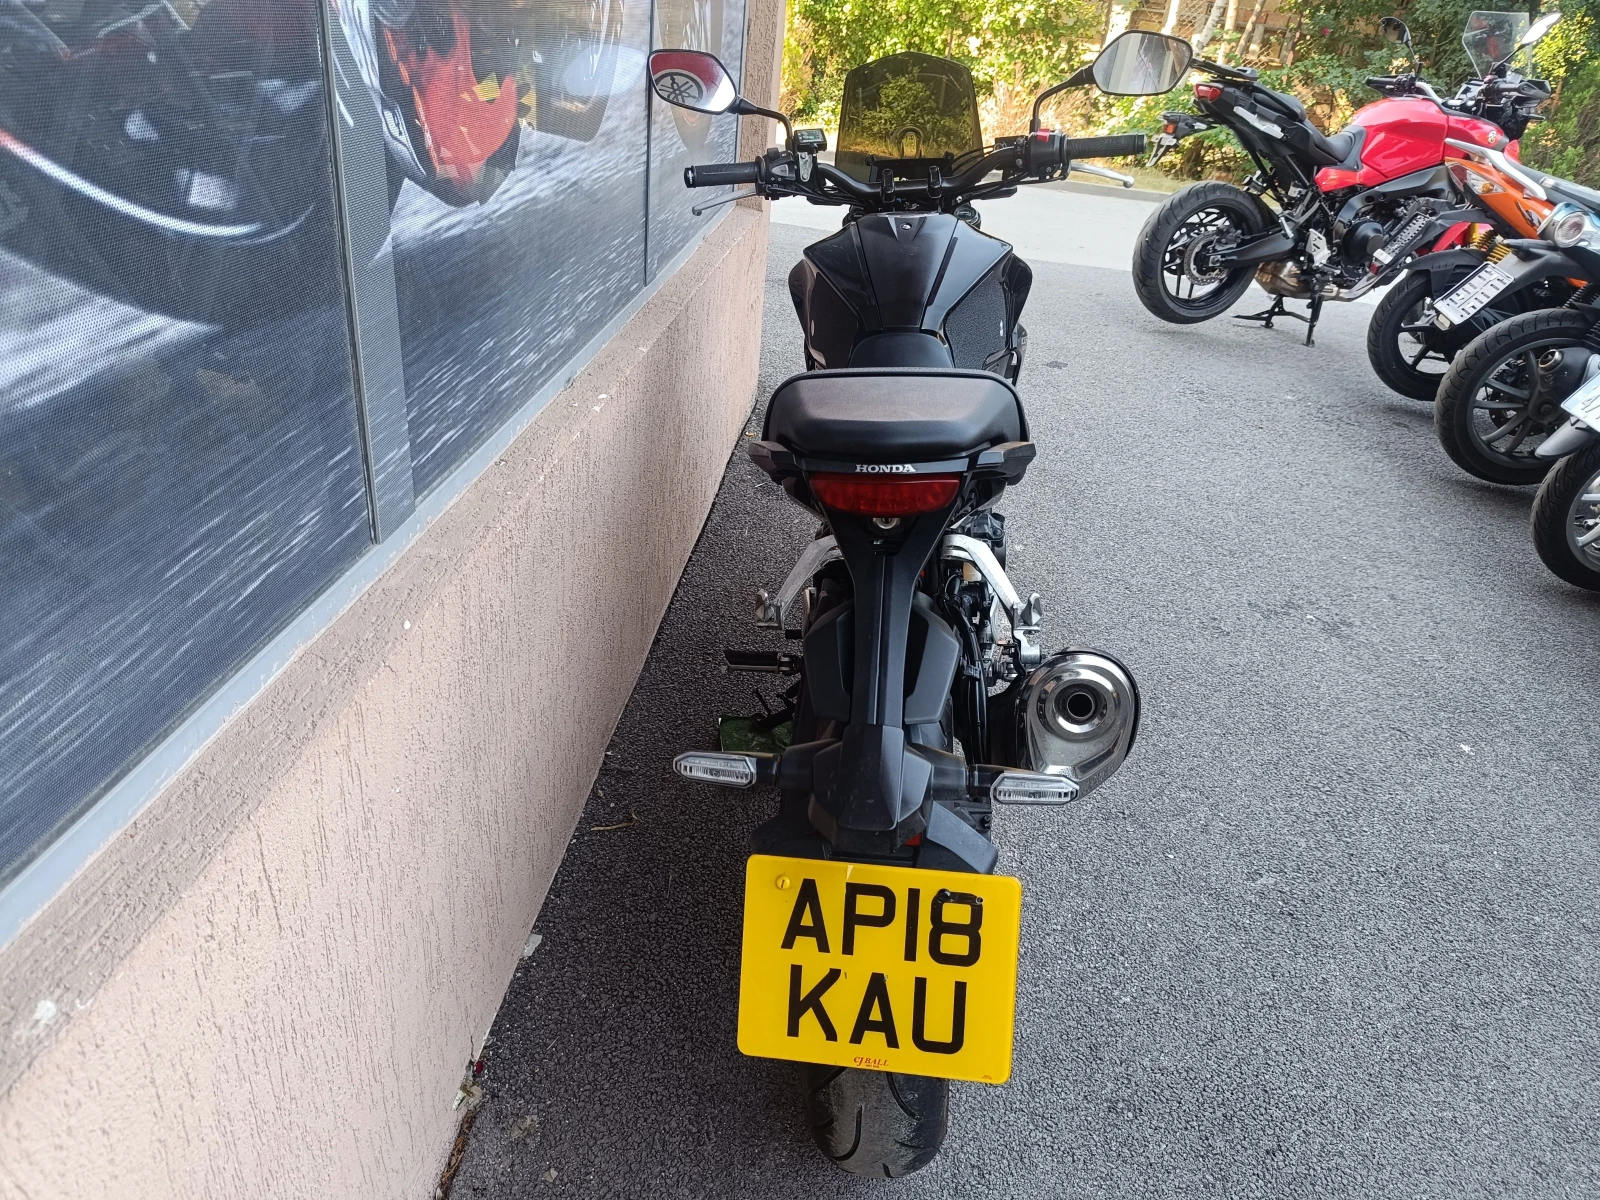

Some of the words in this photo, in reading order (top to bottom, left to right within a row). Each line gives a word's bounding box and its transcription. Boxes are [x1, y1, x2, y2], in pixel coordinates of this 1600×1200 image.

[855, 463, 916, 473] HONDA
[780, 877, 983, 968] AP18
[786, 963, 968, 1055] KAU
